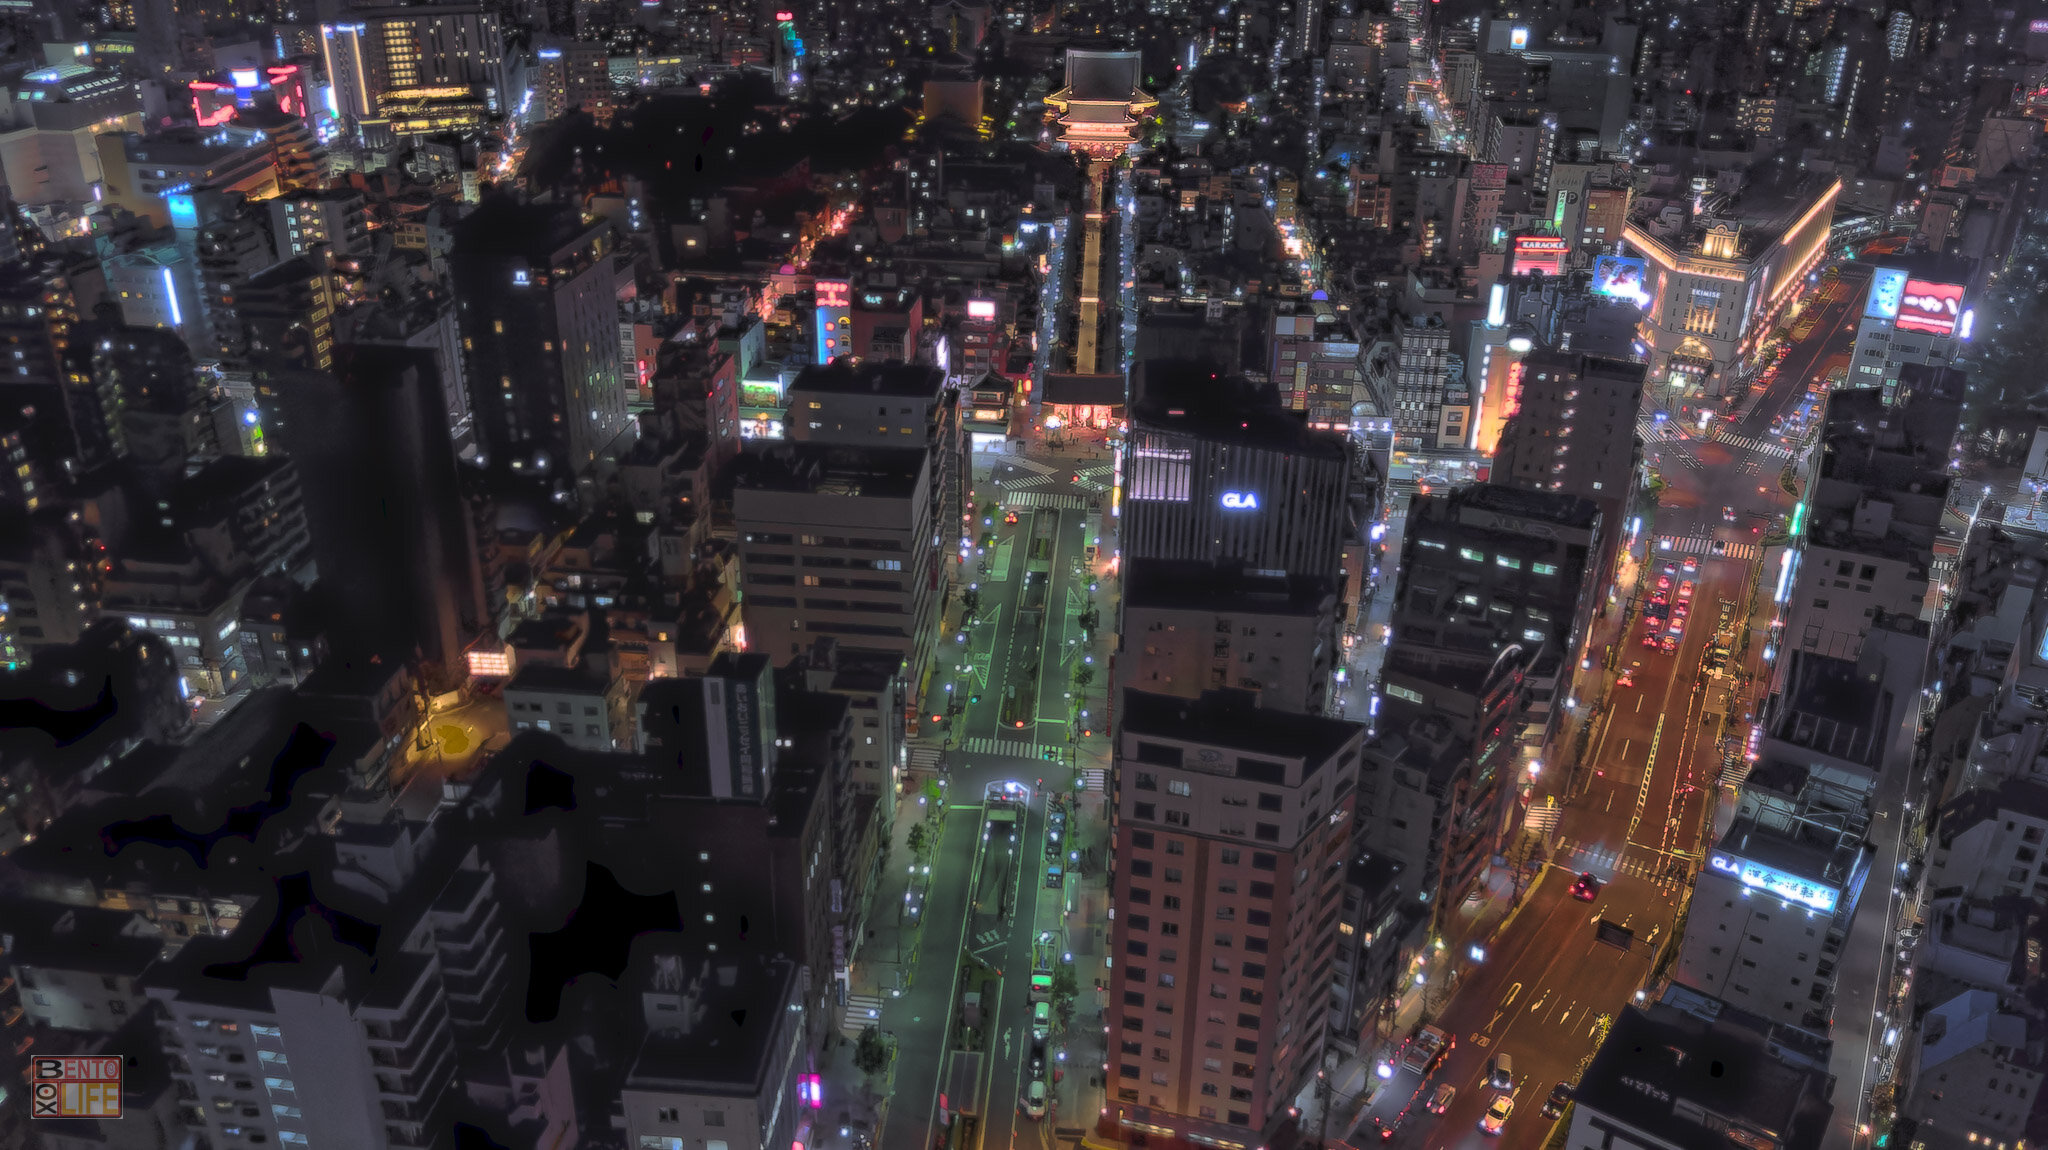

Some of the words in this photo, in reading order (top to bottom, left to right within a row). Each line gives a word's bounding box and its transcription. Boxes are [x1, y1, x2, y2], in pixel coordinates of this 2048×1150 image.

[1521, 241, 1565, 249] KARAOKE
[1691, 288, 1721, 299] EKIMISE
[1222, 492, 1257, 509] GLA
[1711, 856, 1740, 875] GLA
